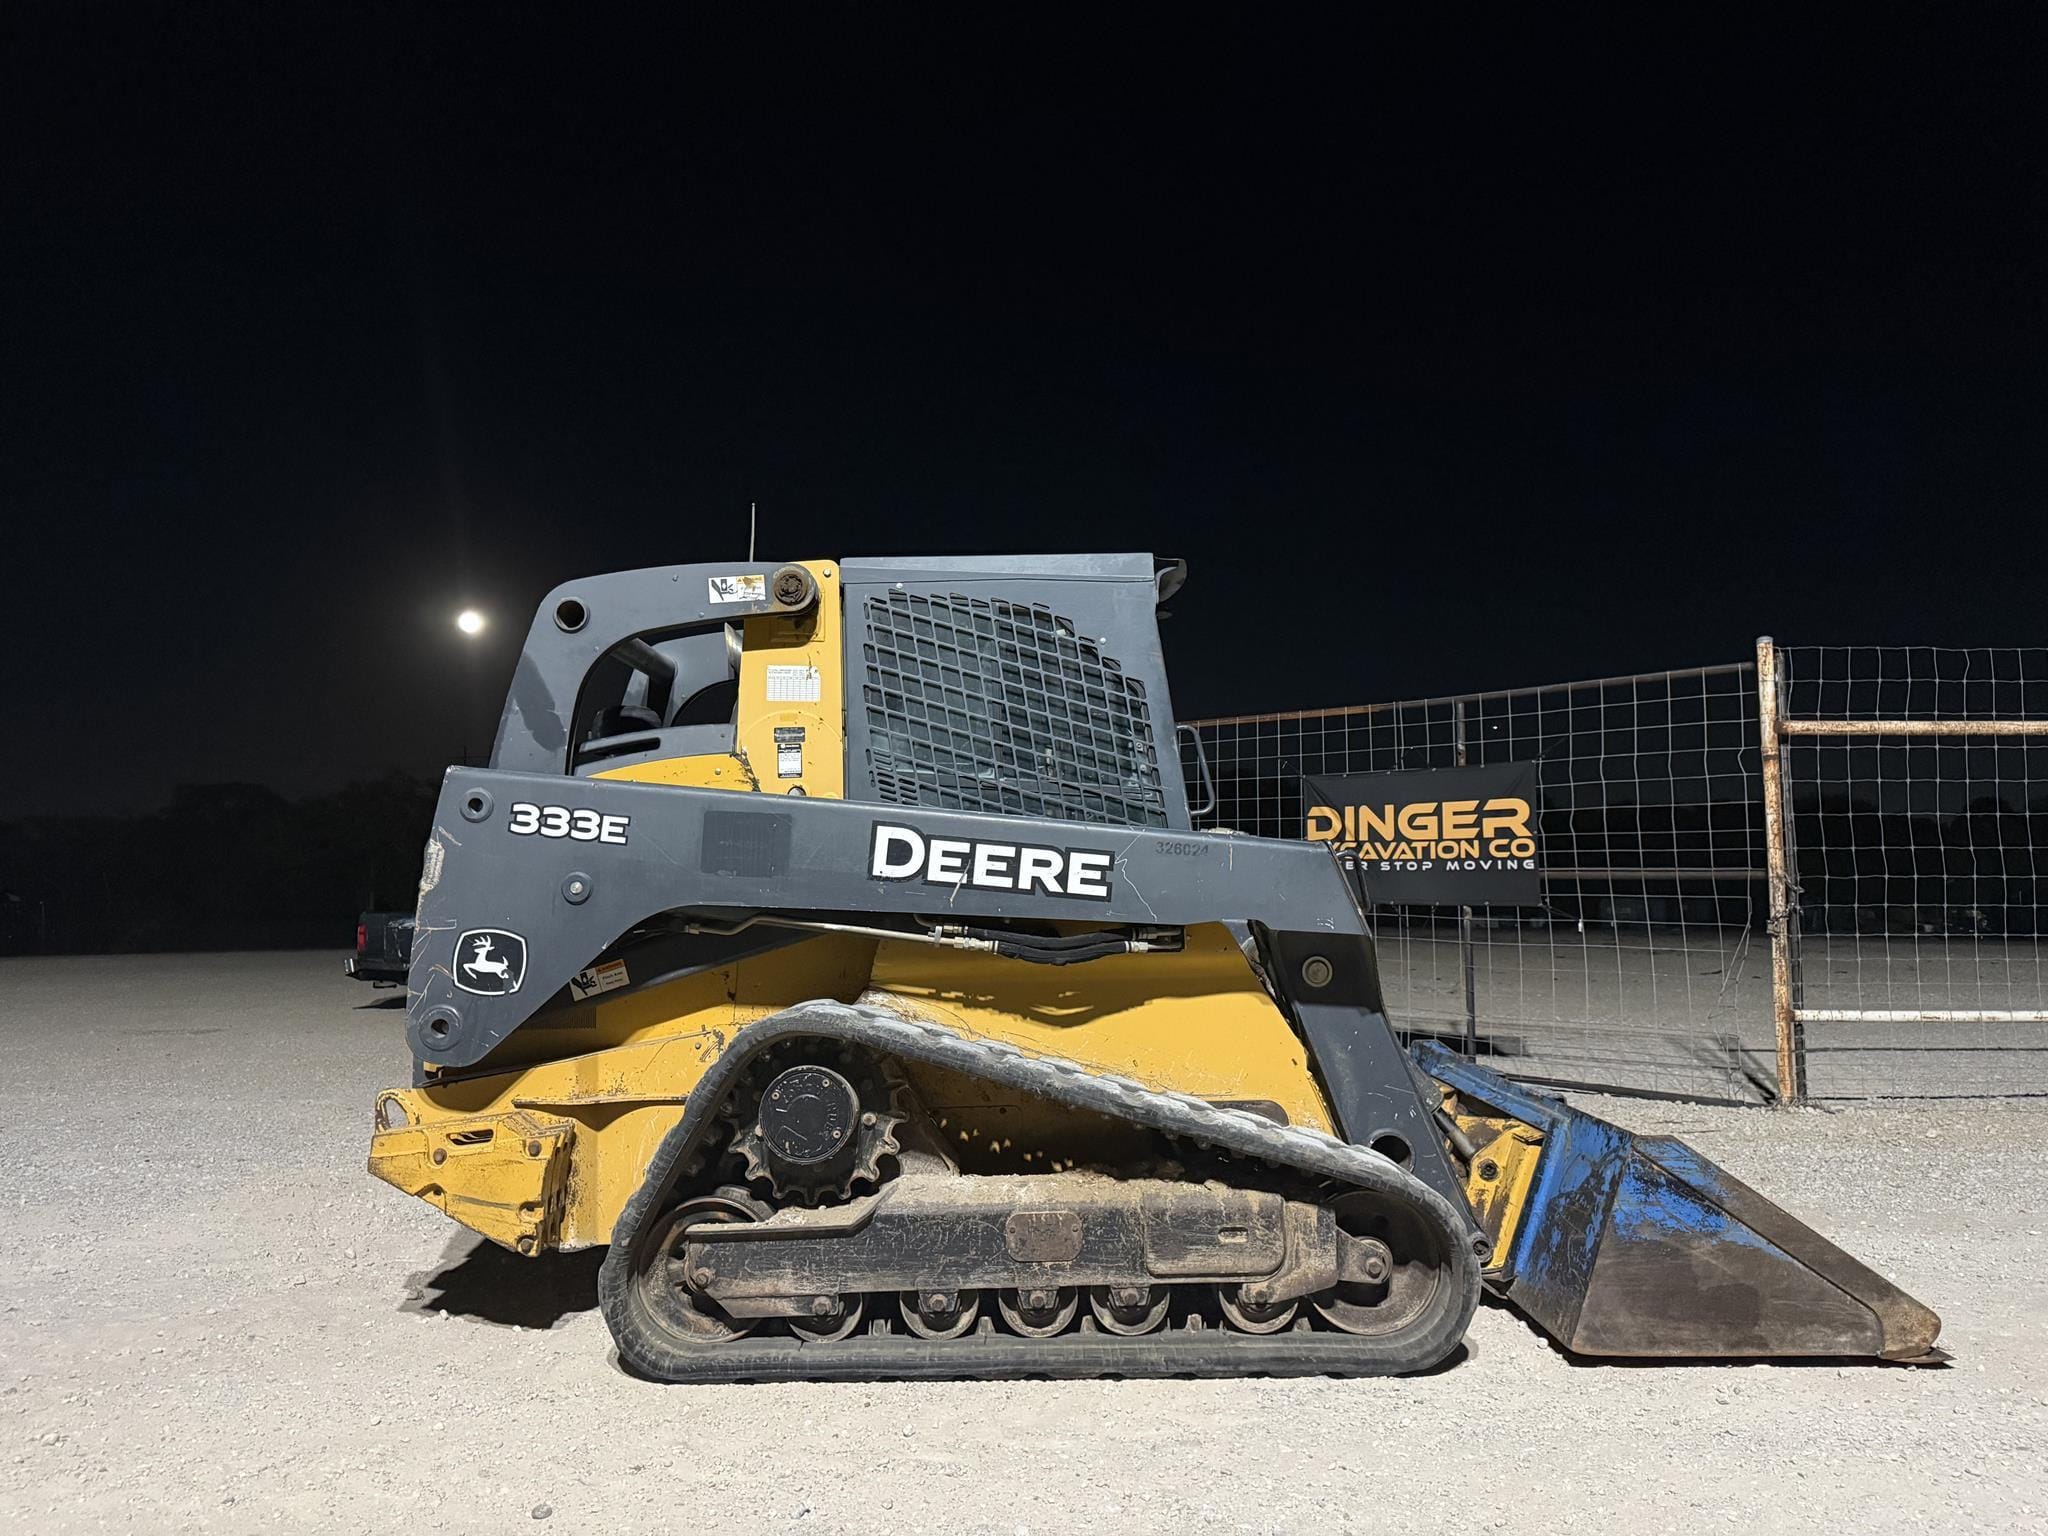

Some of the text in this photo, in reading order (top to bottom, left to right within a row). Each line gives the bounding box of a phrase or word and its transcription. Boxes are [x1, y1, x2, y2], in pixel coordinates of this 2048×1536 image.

[509, 802, 630, 845] 333E
[1306, 798, 1533, 841] DINGER
[870, 823, 1112, 899] DEERE
[1332, 838, 1536, 860] CAVATION CO
[1380, 861, 1433, 871] STOP
[1446, 859, 1535, 871] MOVING
